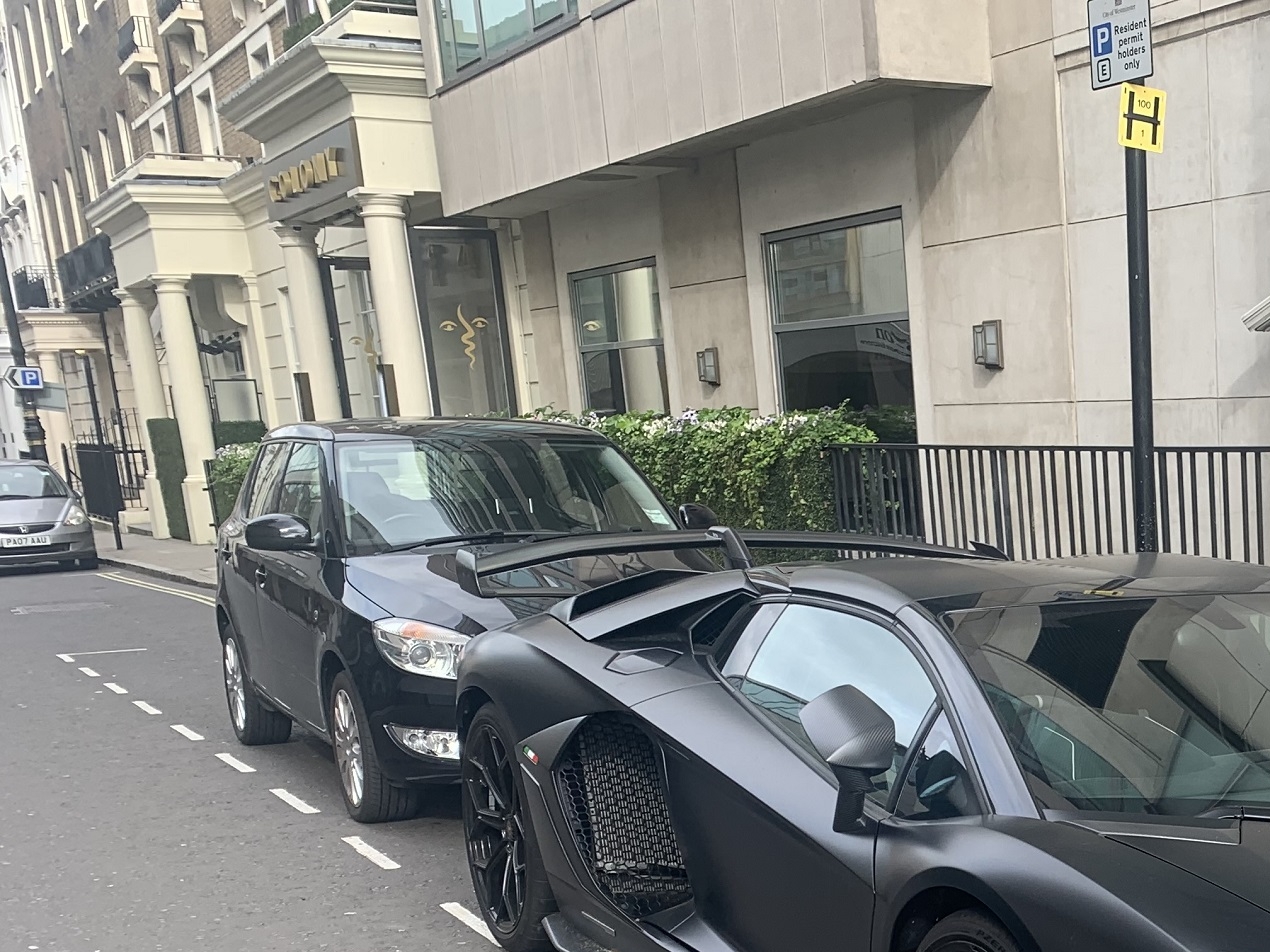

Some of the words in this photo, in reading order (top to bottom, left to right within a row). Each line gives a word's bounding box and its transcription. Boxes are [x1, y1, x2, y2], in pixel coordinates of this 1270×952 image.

[1114, 18, 1147, 35] Resident
[1097, 27, 1110, 54] P
[1118, 32, 1144, 49] permit
[1117, 45, 1146, 60] holders
[1101, 64, 1107, 77] E
[1124, 59, 1140, 71] only
[1138, 99, 1151, 109] 100
[6, 537, 28, 546] PA07
